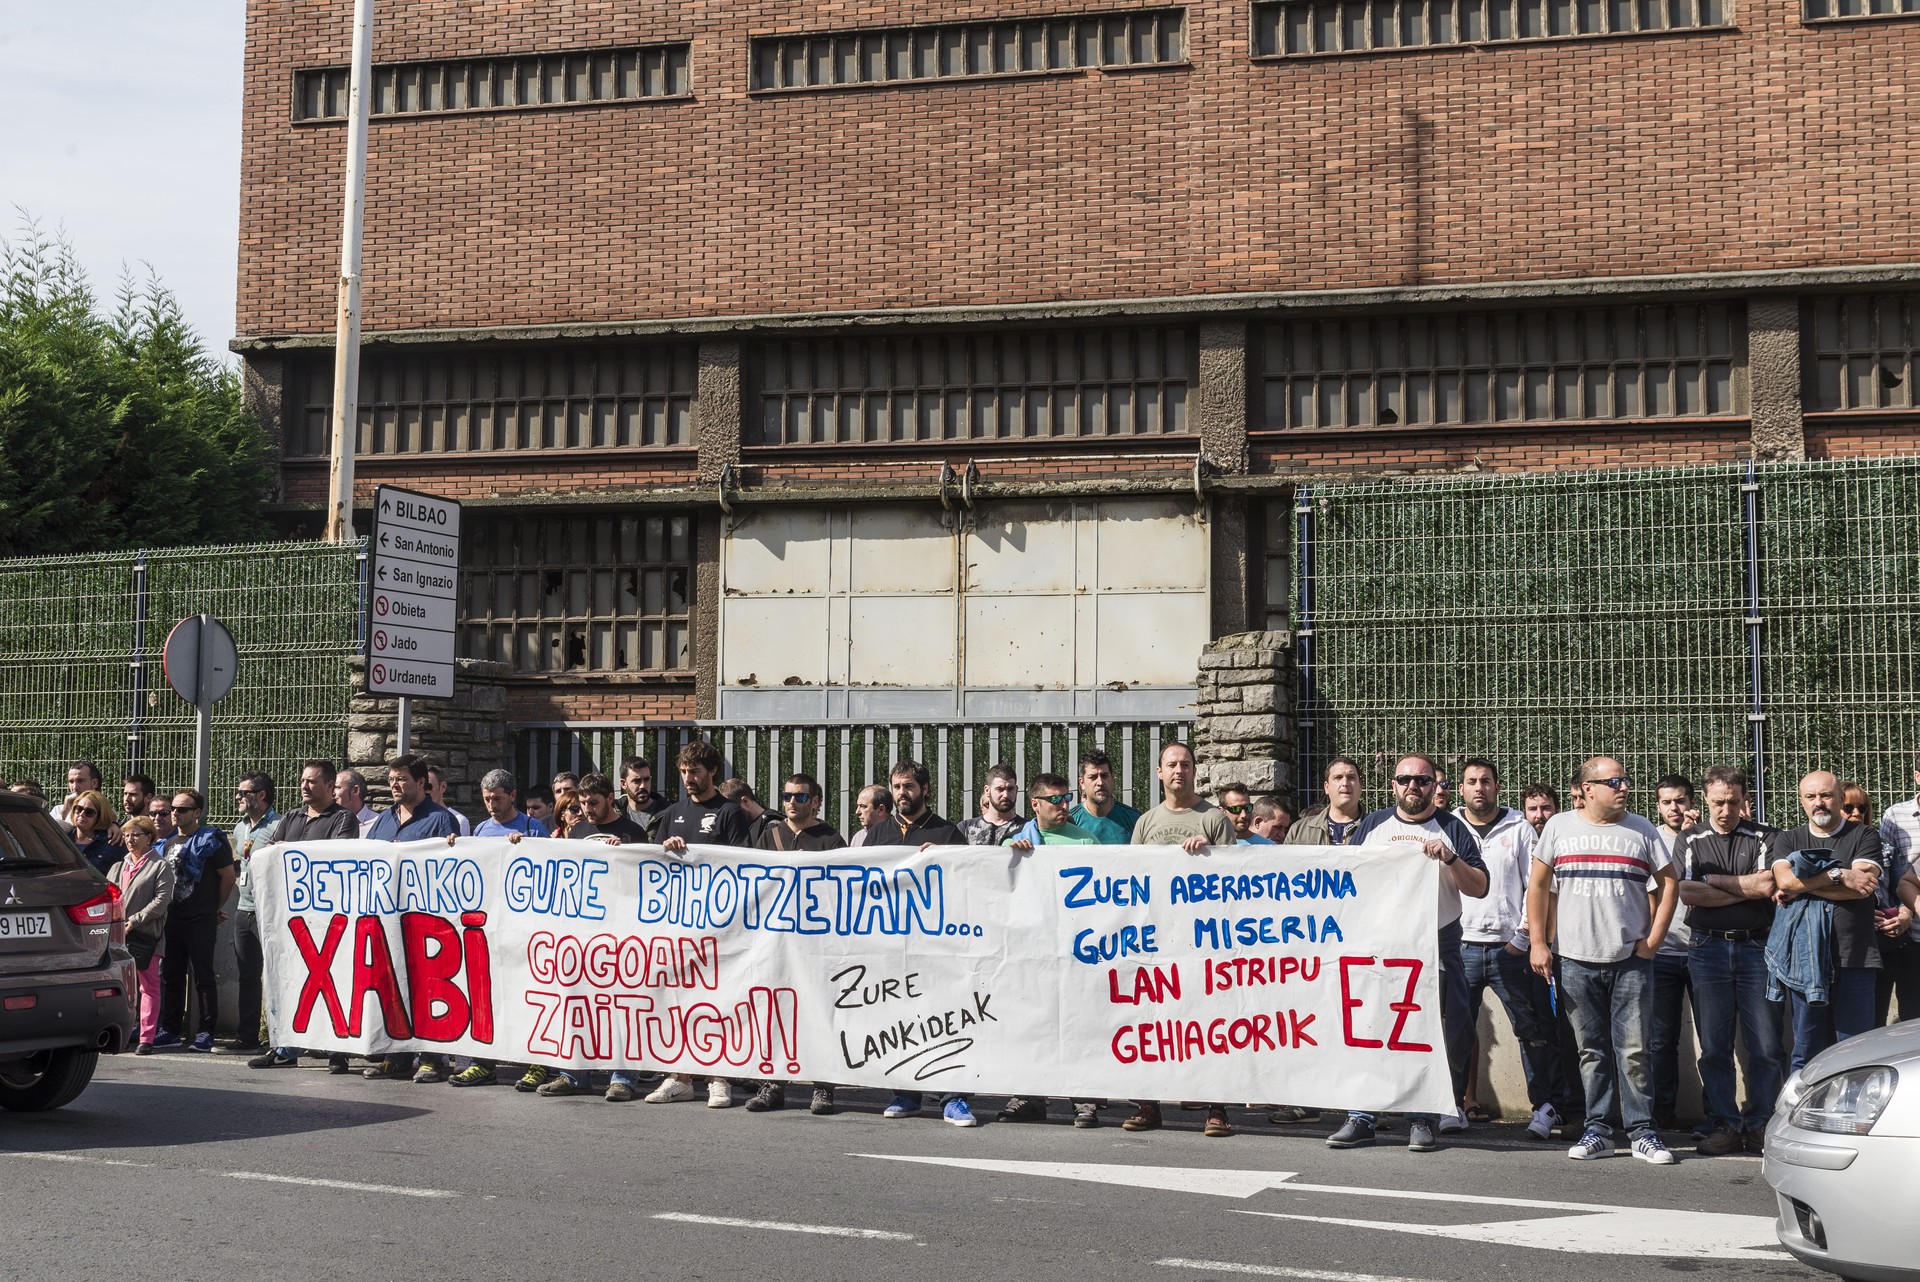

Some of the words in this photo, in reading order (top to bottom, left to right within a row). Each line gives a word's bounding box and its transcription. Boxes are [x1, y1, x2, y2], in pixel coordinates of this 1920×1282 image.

[396, 501, 447, 525] BILBAO
[395, 535, 414, 552] San
[415, 540, 454, 558] Antonio
[393, 567, 413, 584] San
[416, 571, 453, 590] Ignazio
[392, 601, 426, 618] Obieta
[391, 635, 418, 651] Jado
[389, 668, 437, 686] Urdaneta
[1559, 834, 1641, 857] BROOKLYN
[505, 857, 609, 920] GURE
[1059, 866, 1151, 909] ZUEN
[1171, 868, 1357, 905] ABERASTASUNA
[527, 931, 719, 990] GOGOAN
[1073, 924, 1159, 965] GURE
[1194, 914, 1344, 950] MISERIA
[830, 965, 923, 1009] ZURE
[1108, 962, 1182, 1005] LAN
[1205, 956, 1321, 996] ISTRIPU
[1339, 955, 1433, 1053] EZ
[1111, 1009, 1318, 1064] GEHIAGORIK
